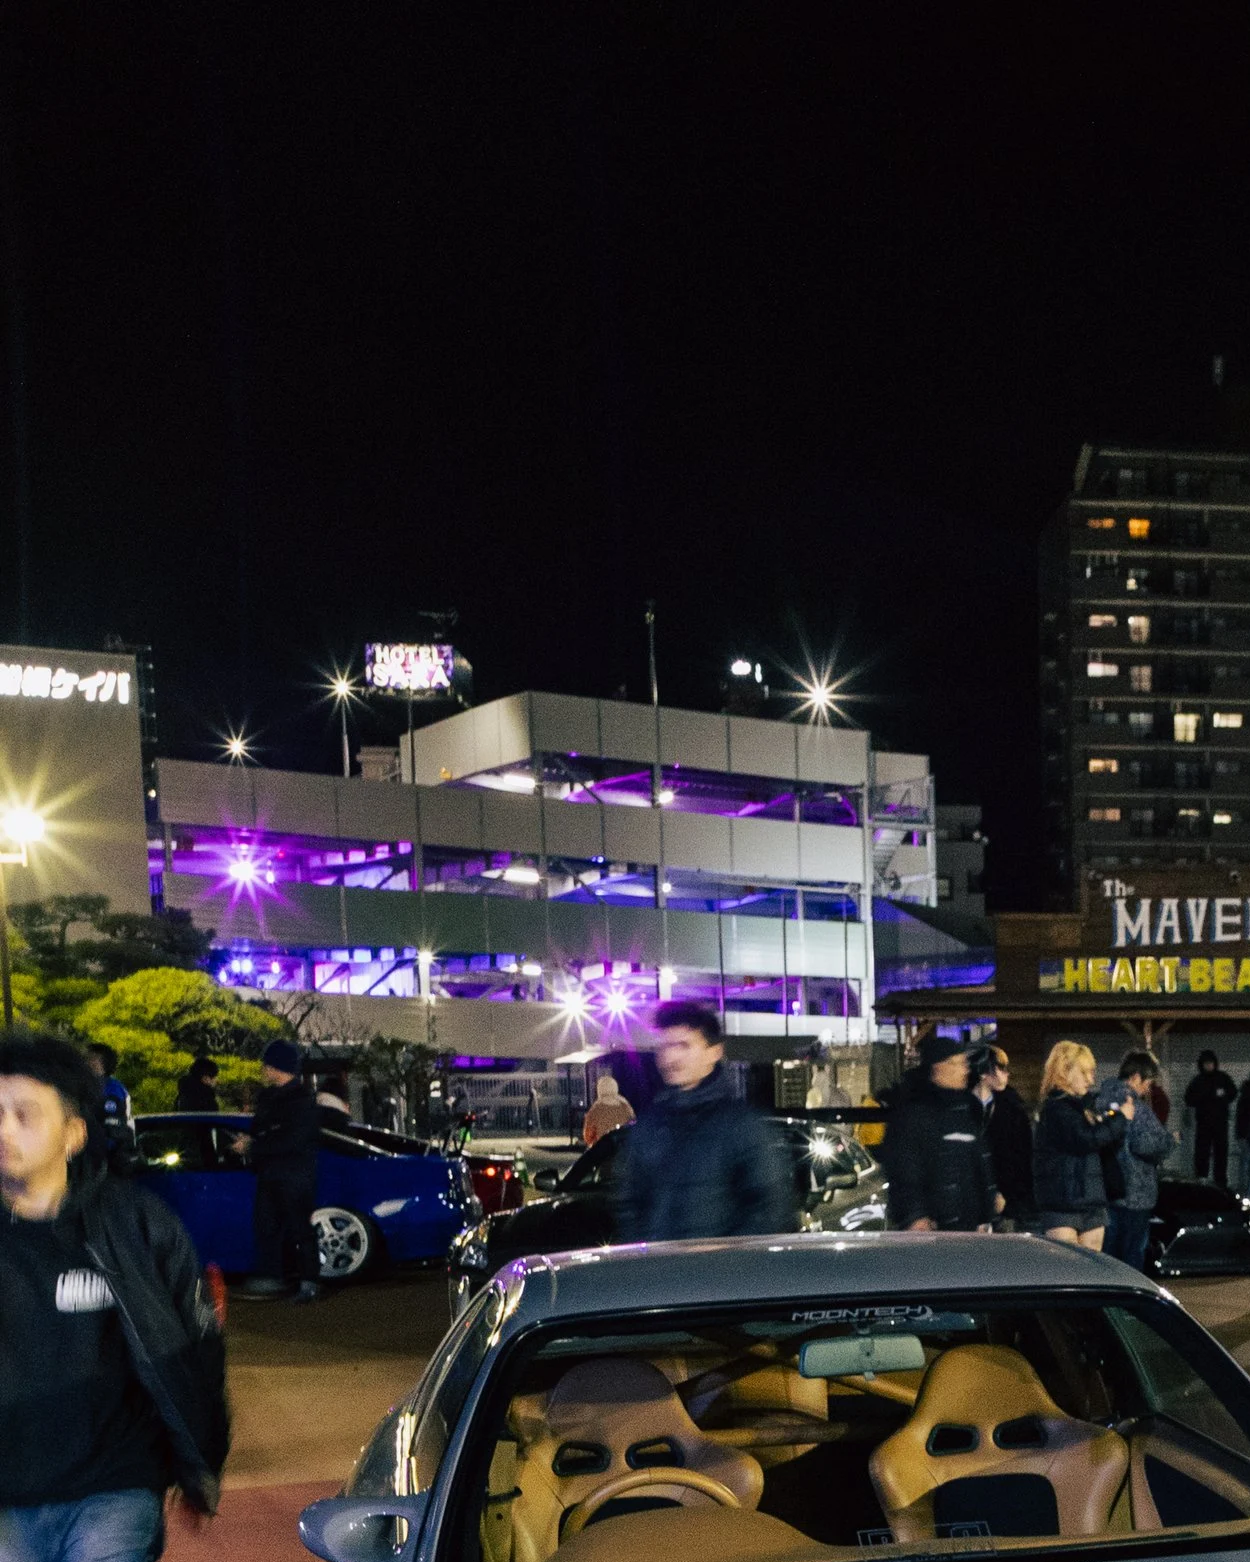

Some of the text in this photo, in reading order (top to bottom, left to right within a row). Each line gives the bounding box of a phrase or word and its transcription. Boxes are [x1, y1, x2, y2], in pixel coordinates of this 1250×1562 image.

[374, 643, 445, 665] HOTEL
[1103, 879, 1135, 897] The
[1063, 956, 1181, 994] HEART
[791, 1305, 923, 1321] MOONTECH
